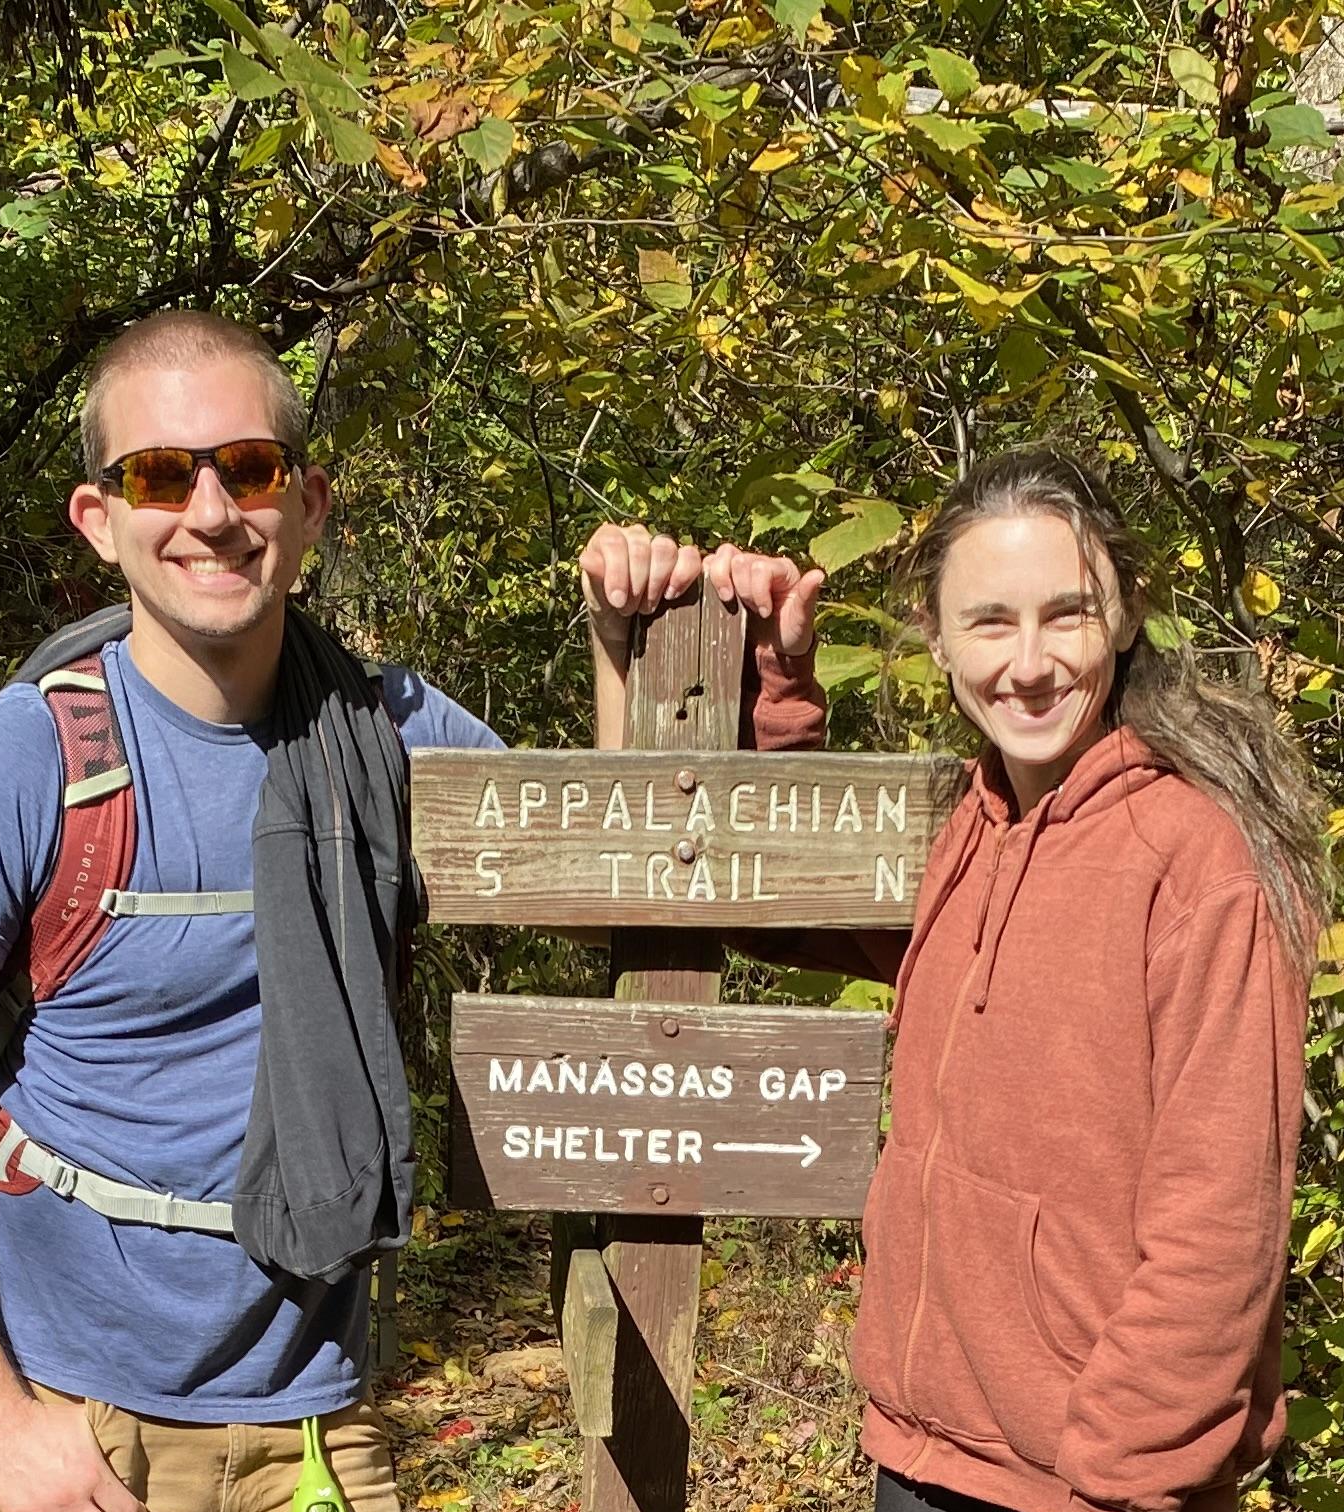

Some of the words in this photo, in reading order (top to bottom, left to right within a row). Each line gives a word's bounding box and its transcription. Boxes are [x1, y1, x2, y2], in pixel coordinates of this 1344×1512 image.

[475, 778, 906, 832] APPALACHIAN
[475, 851, 502, 897] S
[599, 851, 779, 901] TRAIL
[874, 854, 905, 902] N
[489, 1058, 734, 1099] MANASSAS
[759, 1067, 847, 1101] GAP
[503, 1125, 703, 1164] SHELTER
